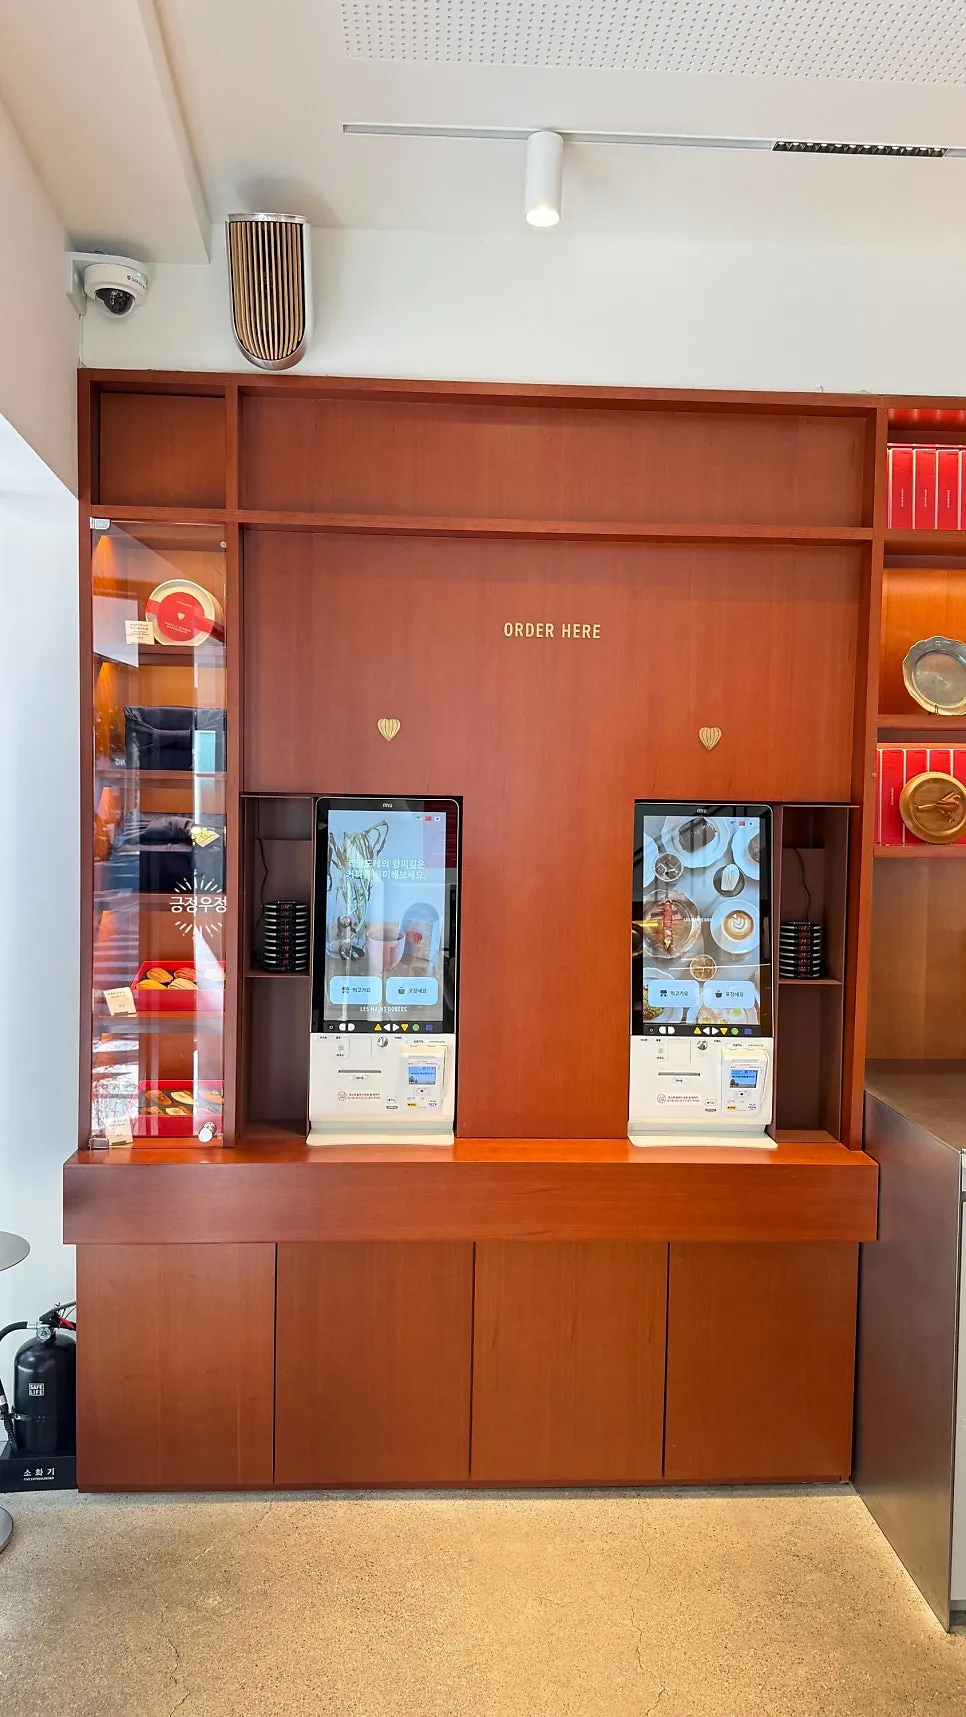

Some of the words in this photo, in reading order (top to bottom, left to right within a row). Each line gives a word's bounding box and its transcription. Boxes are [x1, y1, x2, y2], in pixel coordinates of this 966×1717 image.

[504, 622, 554, 638] ORDER
[562, 623, 601, 639] HERE
[392, 859, 425, 870] 향미깊은
[169, 896, 227, 913] 긍정우정
